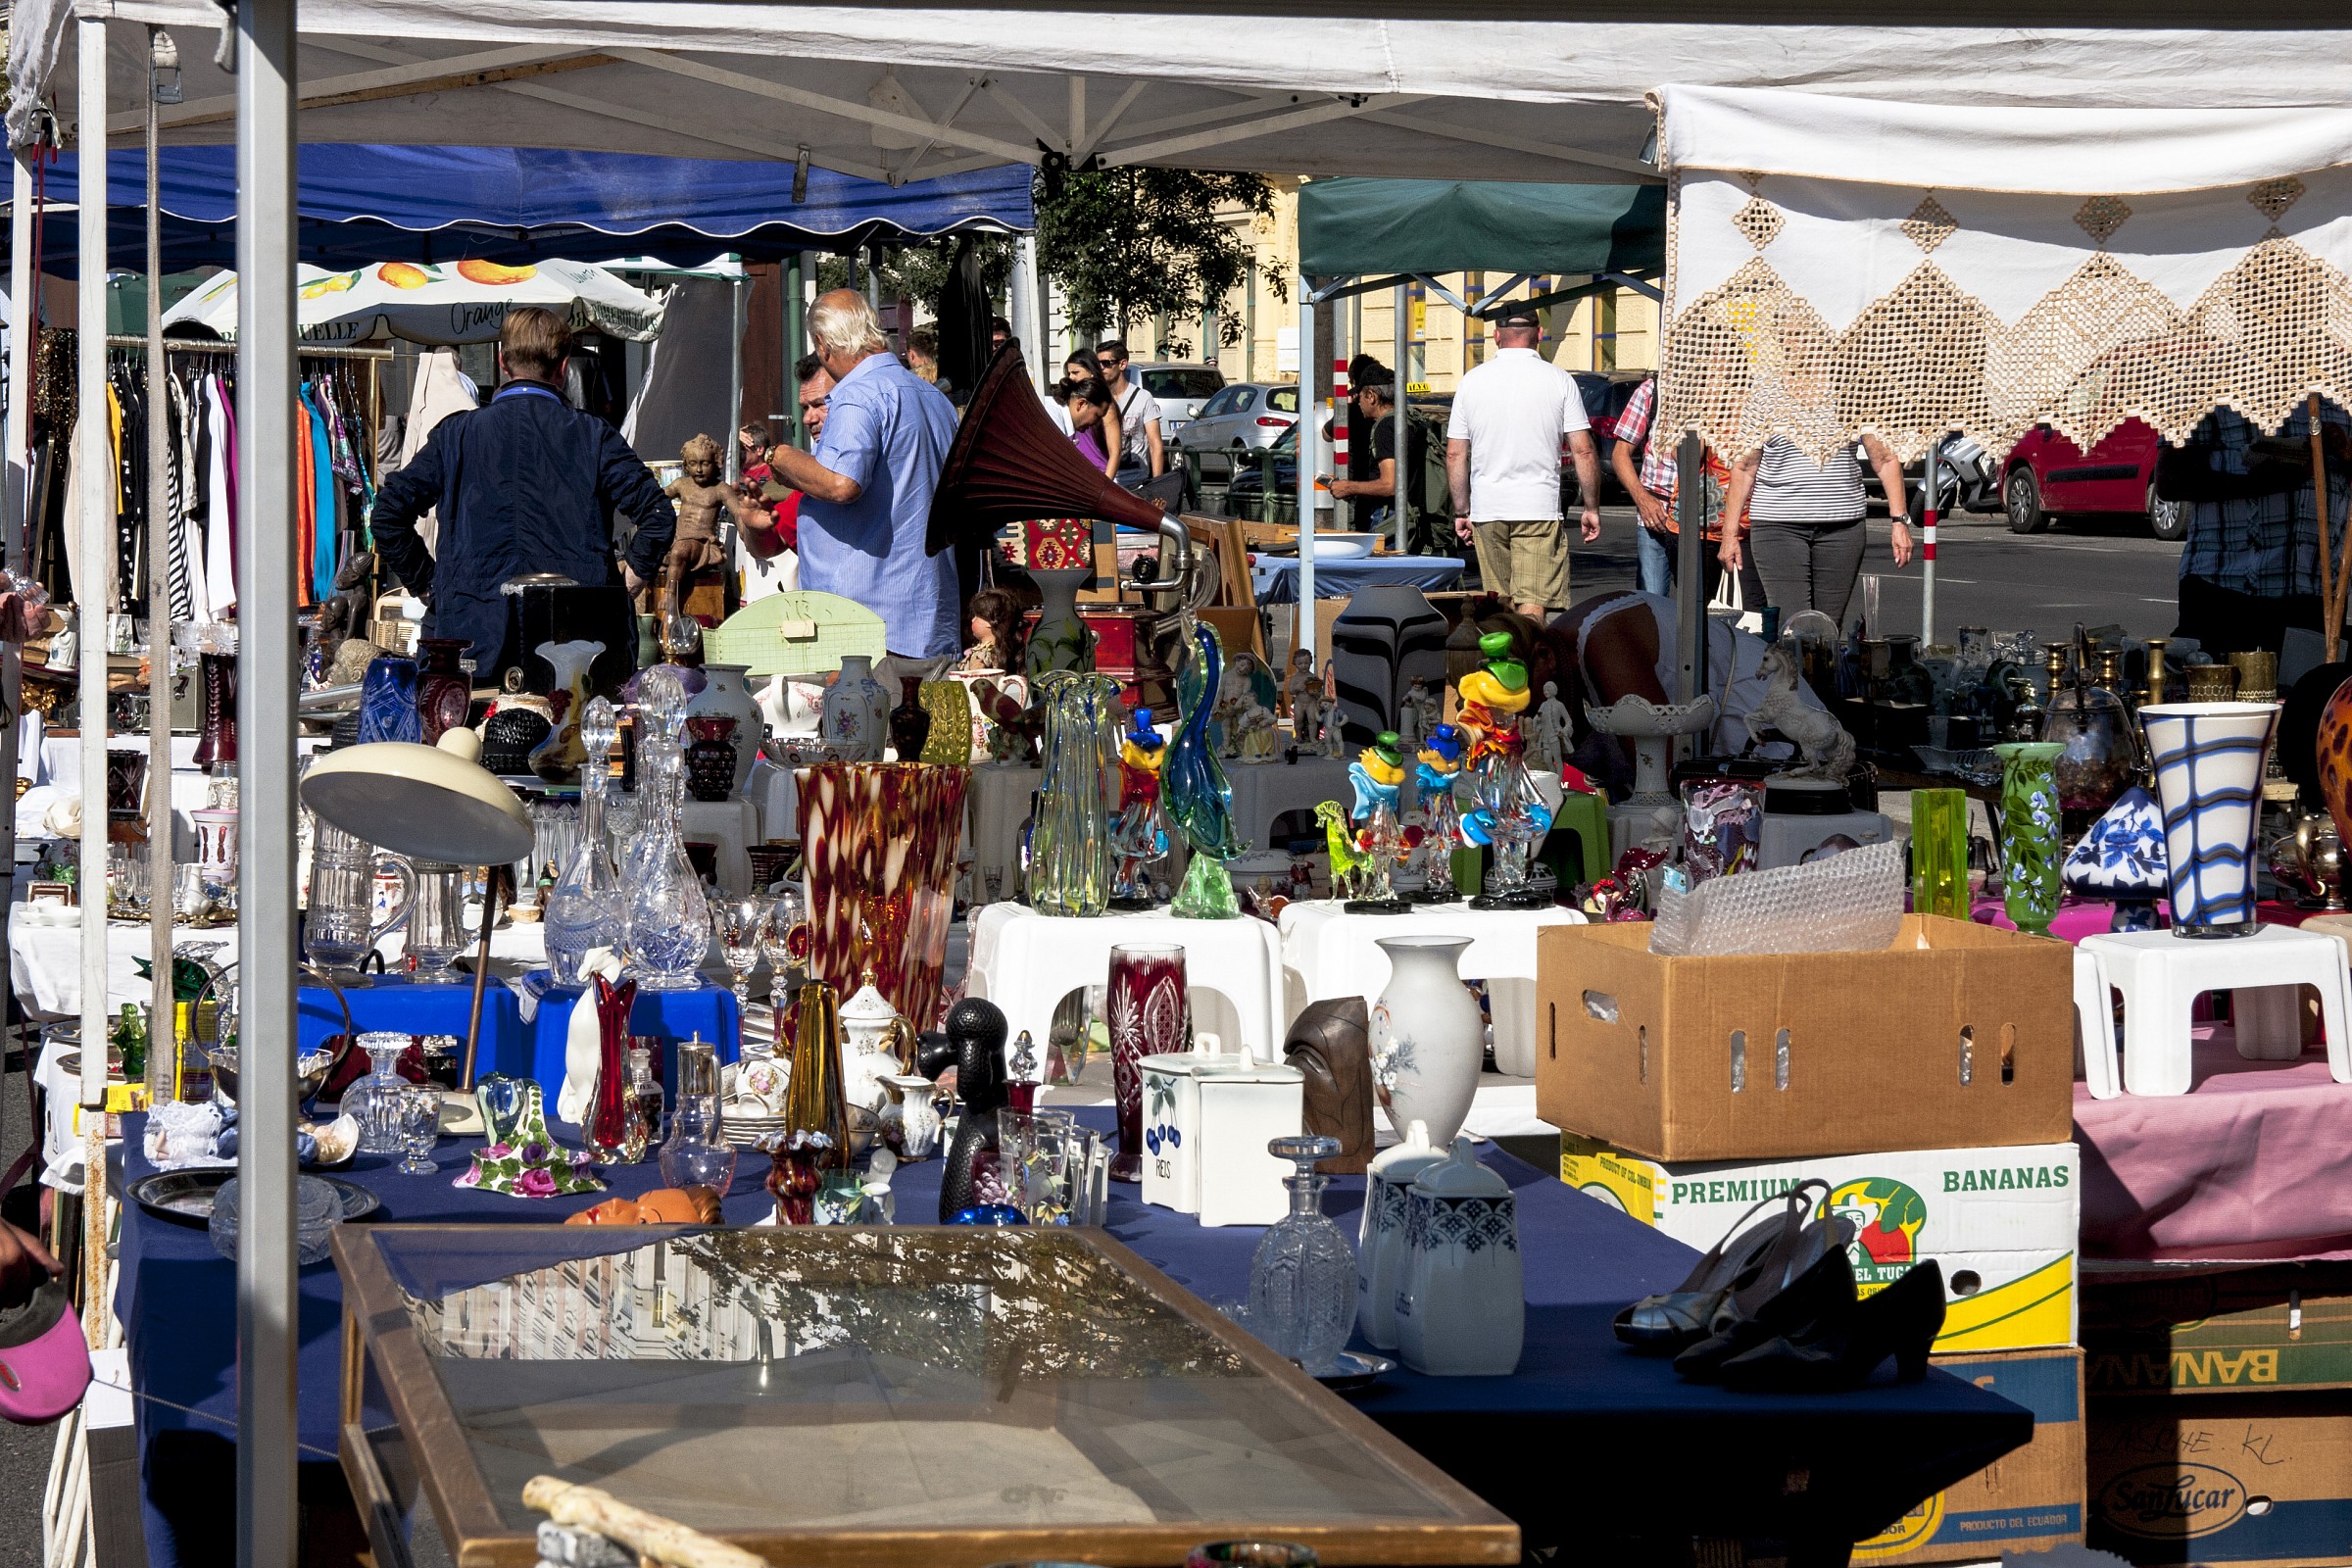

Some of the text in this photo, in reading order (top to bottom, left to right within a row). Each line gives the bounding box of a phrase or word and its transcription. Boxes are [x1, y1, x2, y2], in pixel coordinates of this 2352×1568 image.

[451, 297, 514, 335] Orange
[1155, 1157, 1171, 1180] REIS
[1599, 1156, 1621, 1176] PRODUCT
[1620, 1166, 1628, 1178] OF
[1943, 1165, 2069, 1192] BANANAS
[1672, 1177, 1800, 1204] PREMIUM
[2113, 1474, 2235, 1520] SanLucar
[1959, 1513, 2068, 1532] PRODUCTO DEL ECUADOR
